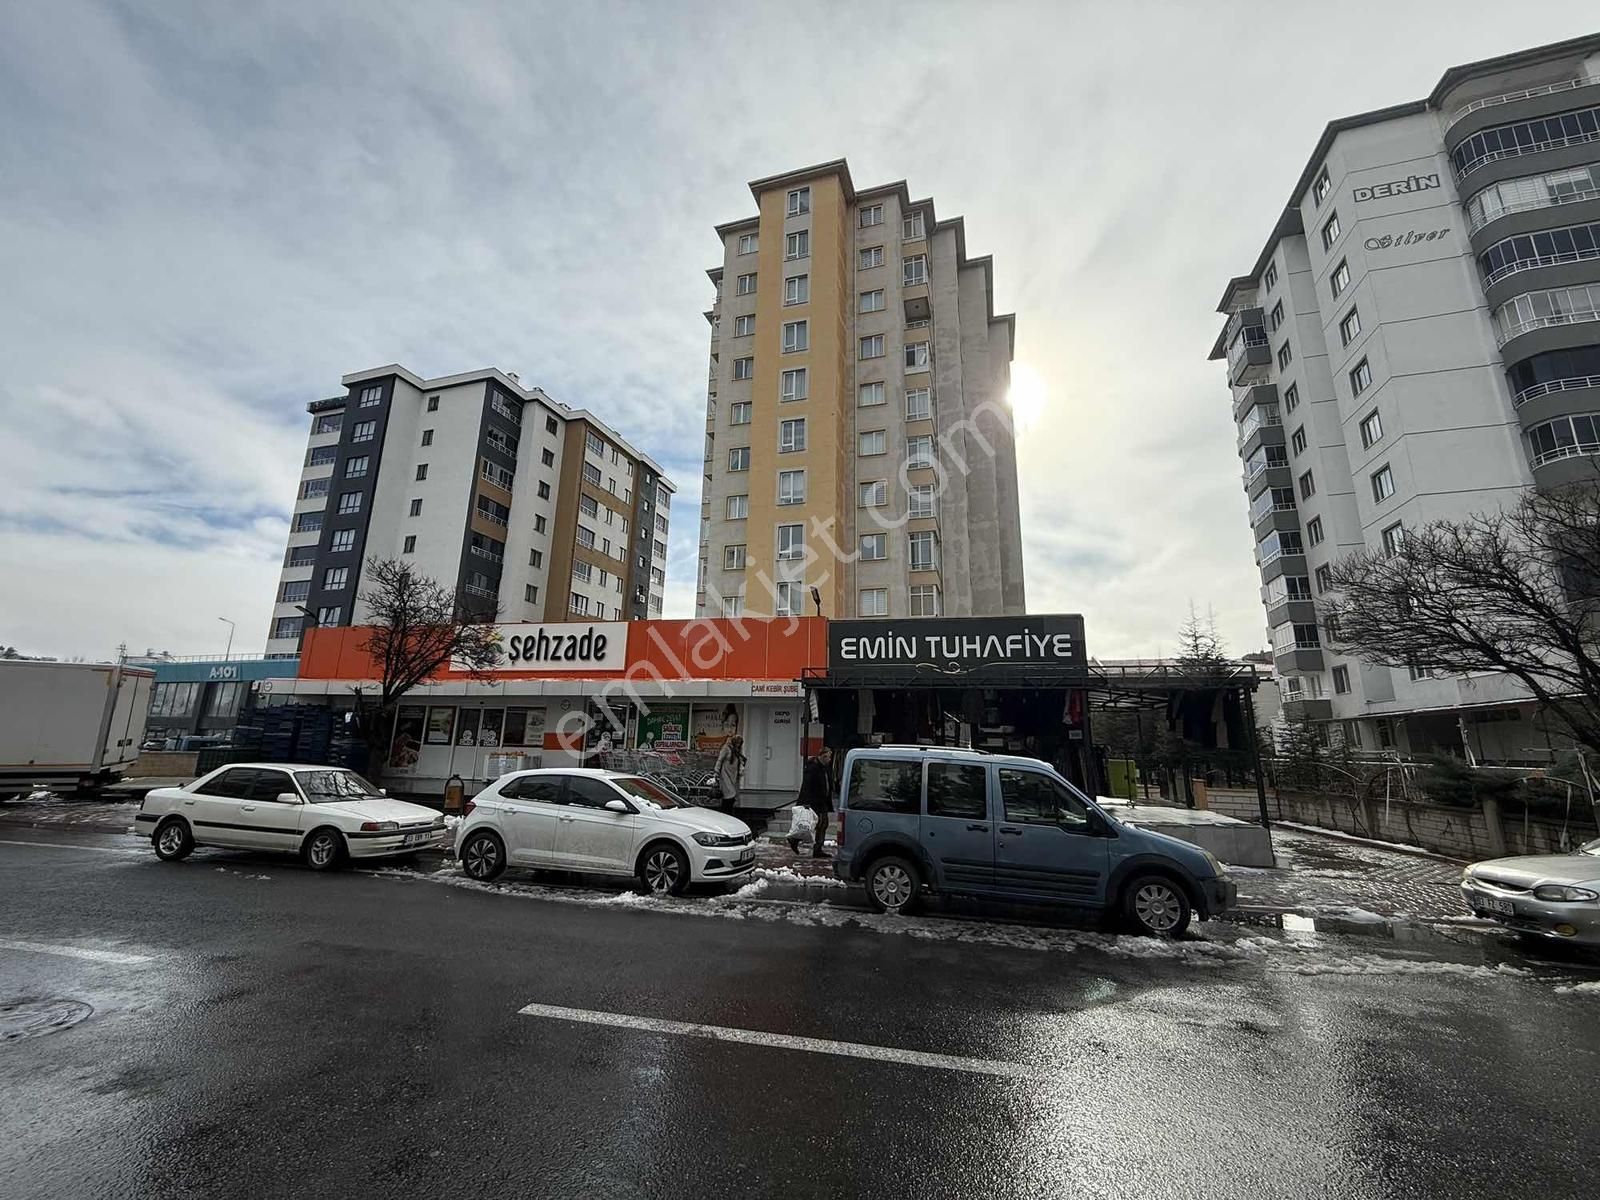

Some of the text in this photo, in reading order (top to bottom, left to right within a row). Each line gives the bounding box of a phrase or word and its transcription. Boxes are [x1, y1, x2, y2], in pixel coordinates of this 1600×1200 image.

[1353, 174, 1440, 202] DERİN
[1364, 229, 1450, 251] Silver
[508, 626, 608, 665] şehzade
[840, 628, 1073, 660] EMİN TUHAFİYE
